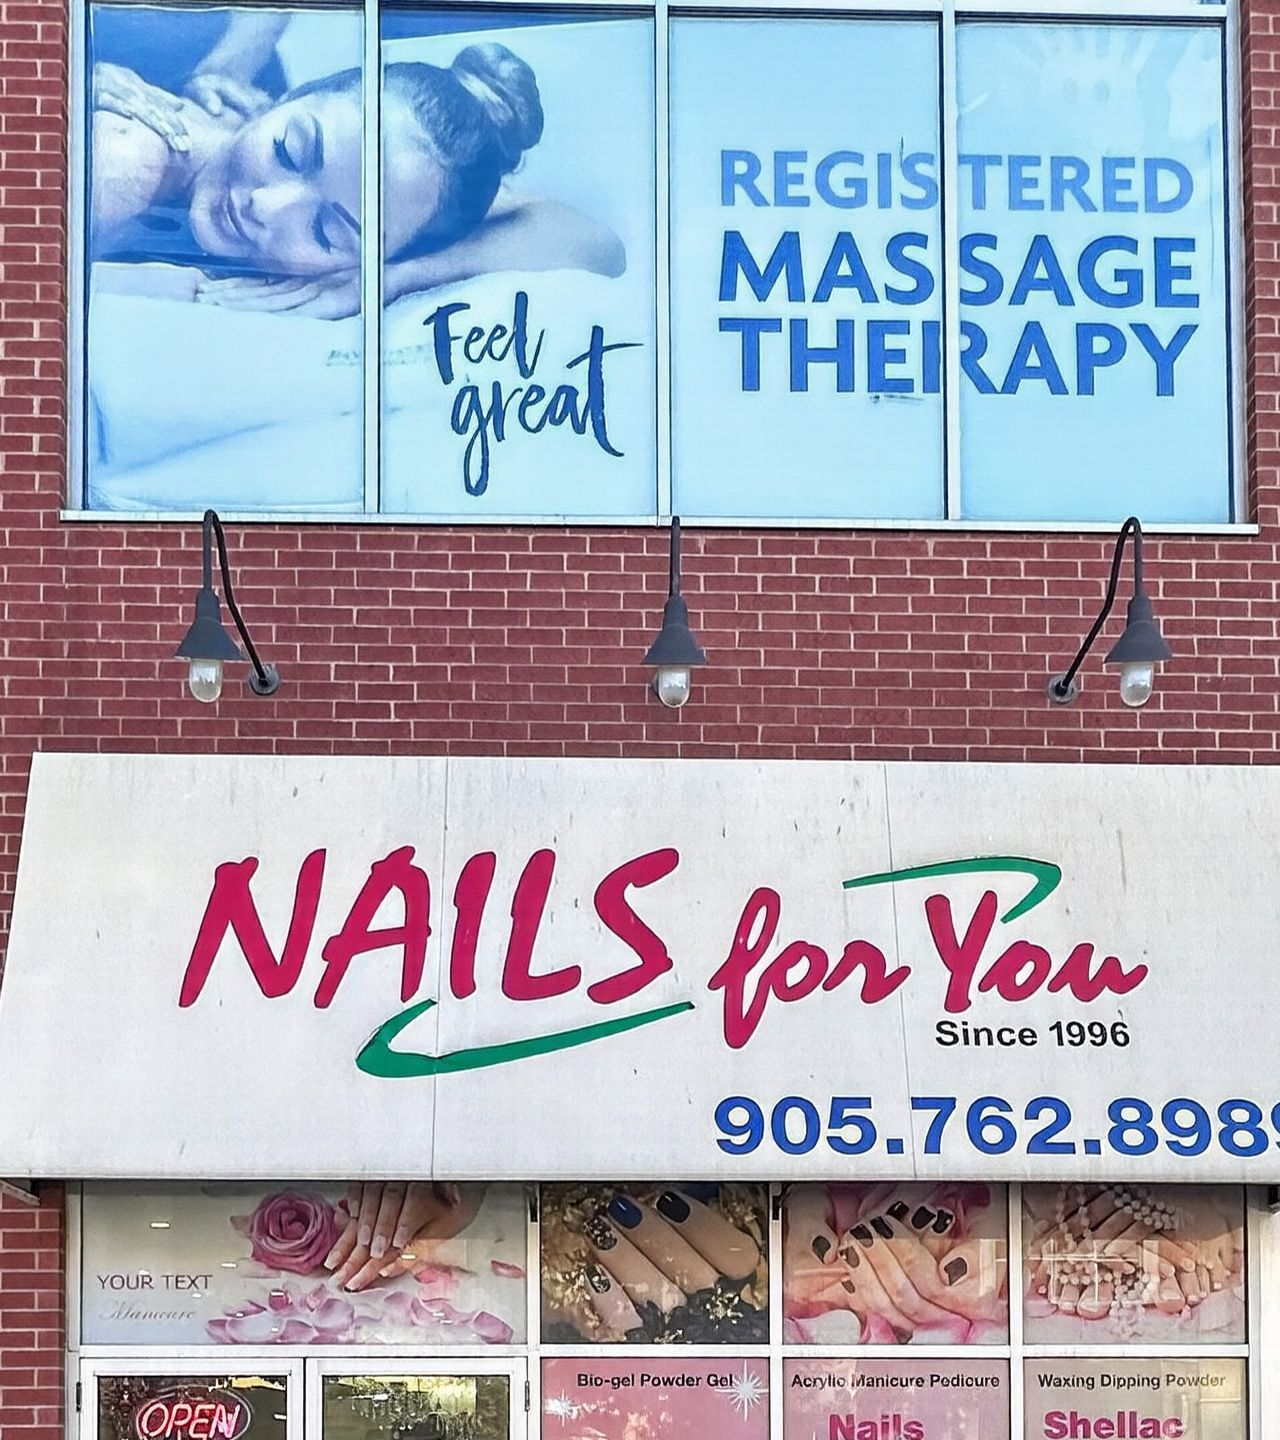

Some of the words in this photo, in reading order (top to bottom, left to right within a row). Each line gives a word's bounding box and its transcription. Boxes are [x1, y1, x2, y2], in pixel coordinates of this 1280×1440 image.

[721, 150, 1195, 214] REGISTERED
[718, 230, 1201, 310] MASSAGE
[423, 291, 545, 385] Feel
[718, 317, 1201, 397] THERAPY
[451, 325, 644, 496] great
[178, 848, 680, 1008] NAILS
[709, 887, 911, 1050] for
[924, 890, 1148, 1013] You
[935, 1021, 1038, 1047] Since
[1049, 1021, 1130, 1047] 1996
[97, 1273, 154, 1290] YOUR
[161, 1273, 213, 1290] TEXT
[577, 1373, 635, 1389] Bio-gel
[640, 1373, 702, 1387] Powder
[707, 1373, 733, 1387] Gel
[791, 1374, 845, 1388] Acrylic
[851, 1374, 925, 1387] Manicure
[930, 1374, 1000, 1387] Pedicure
[1038, 1374, 1095, 1389] Waxing
[1101, 1374, 1160, 1389] Dipping
[1166, 1374, 1226, 1387] Powder
[141, 1402, 241, 1440] OPEN
[1044, 1411, 1184, 1439] Shellac
